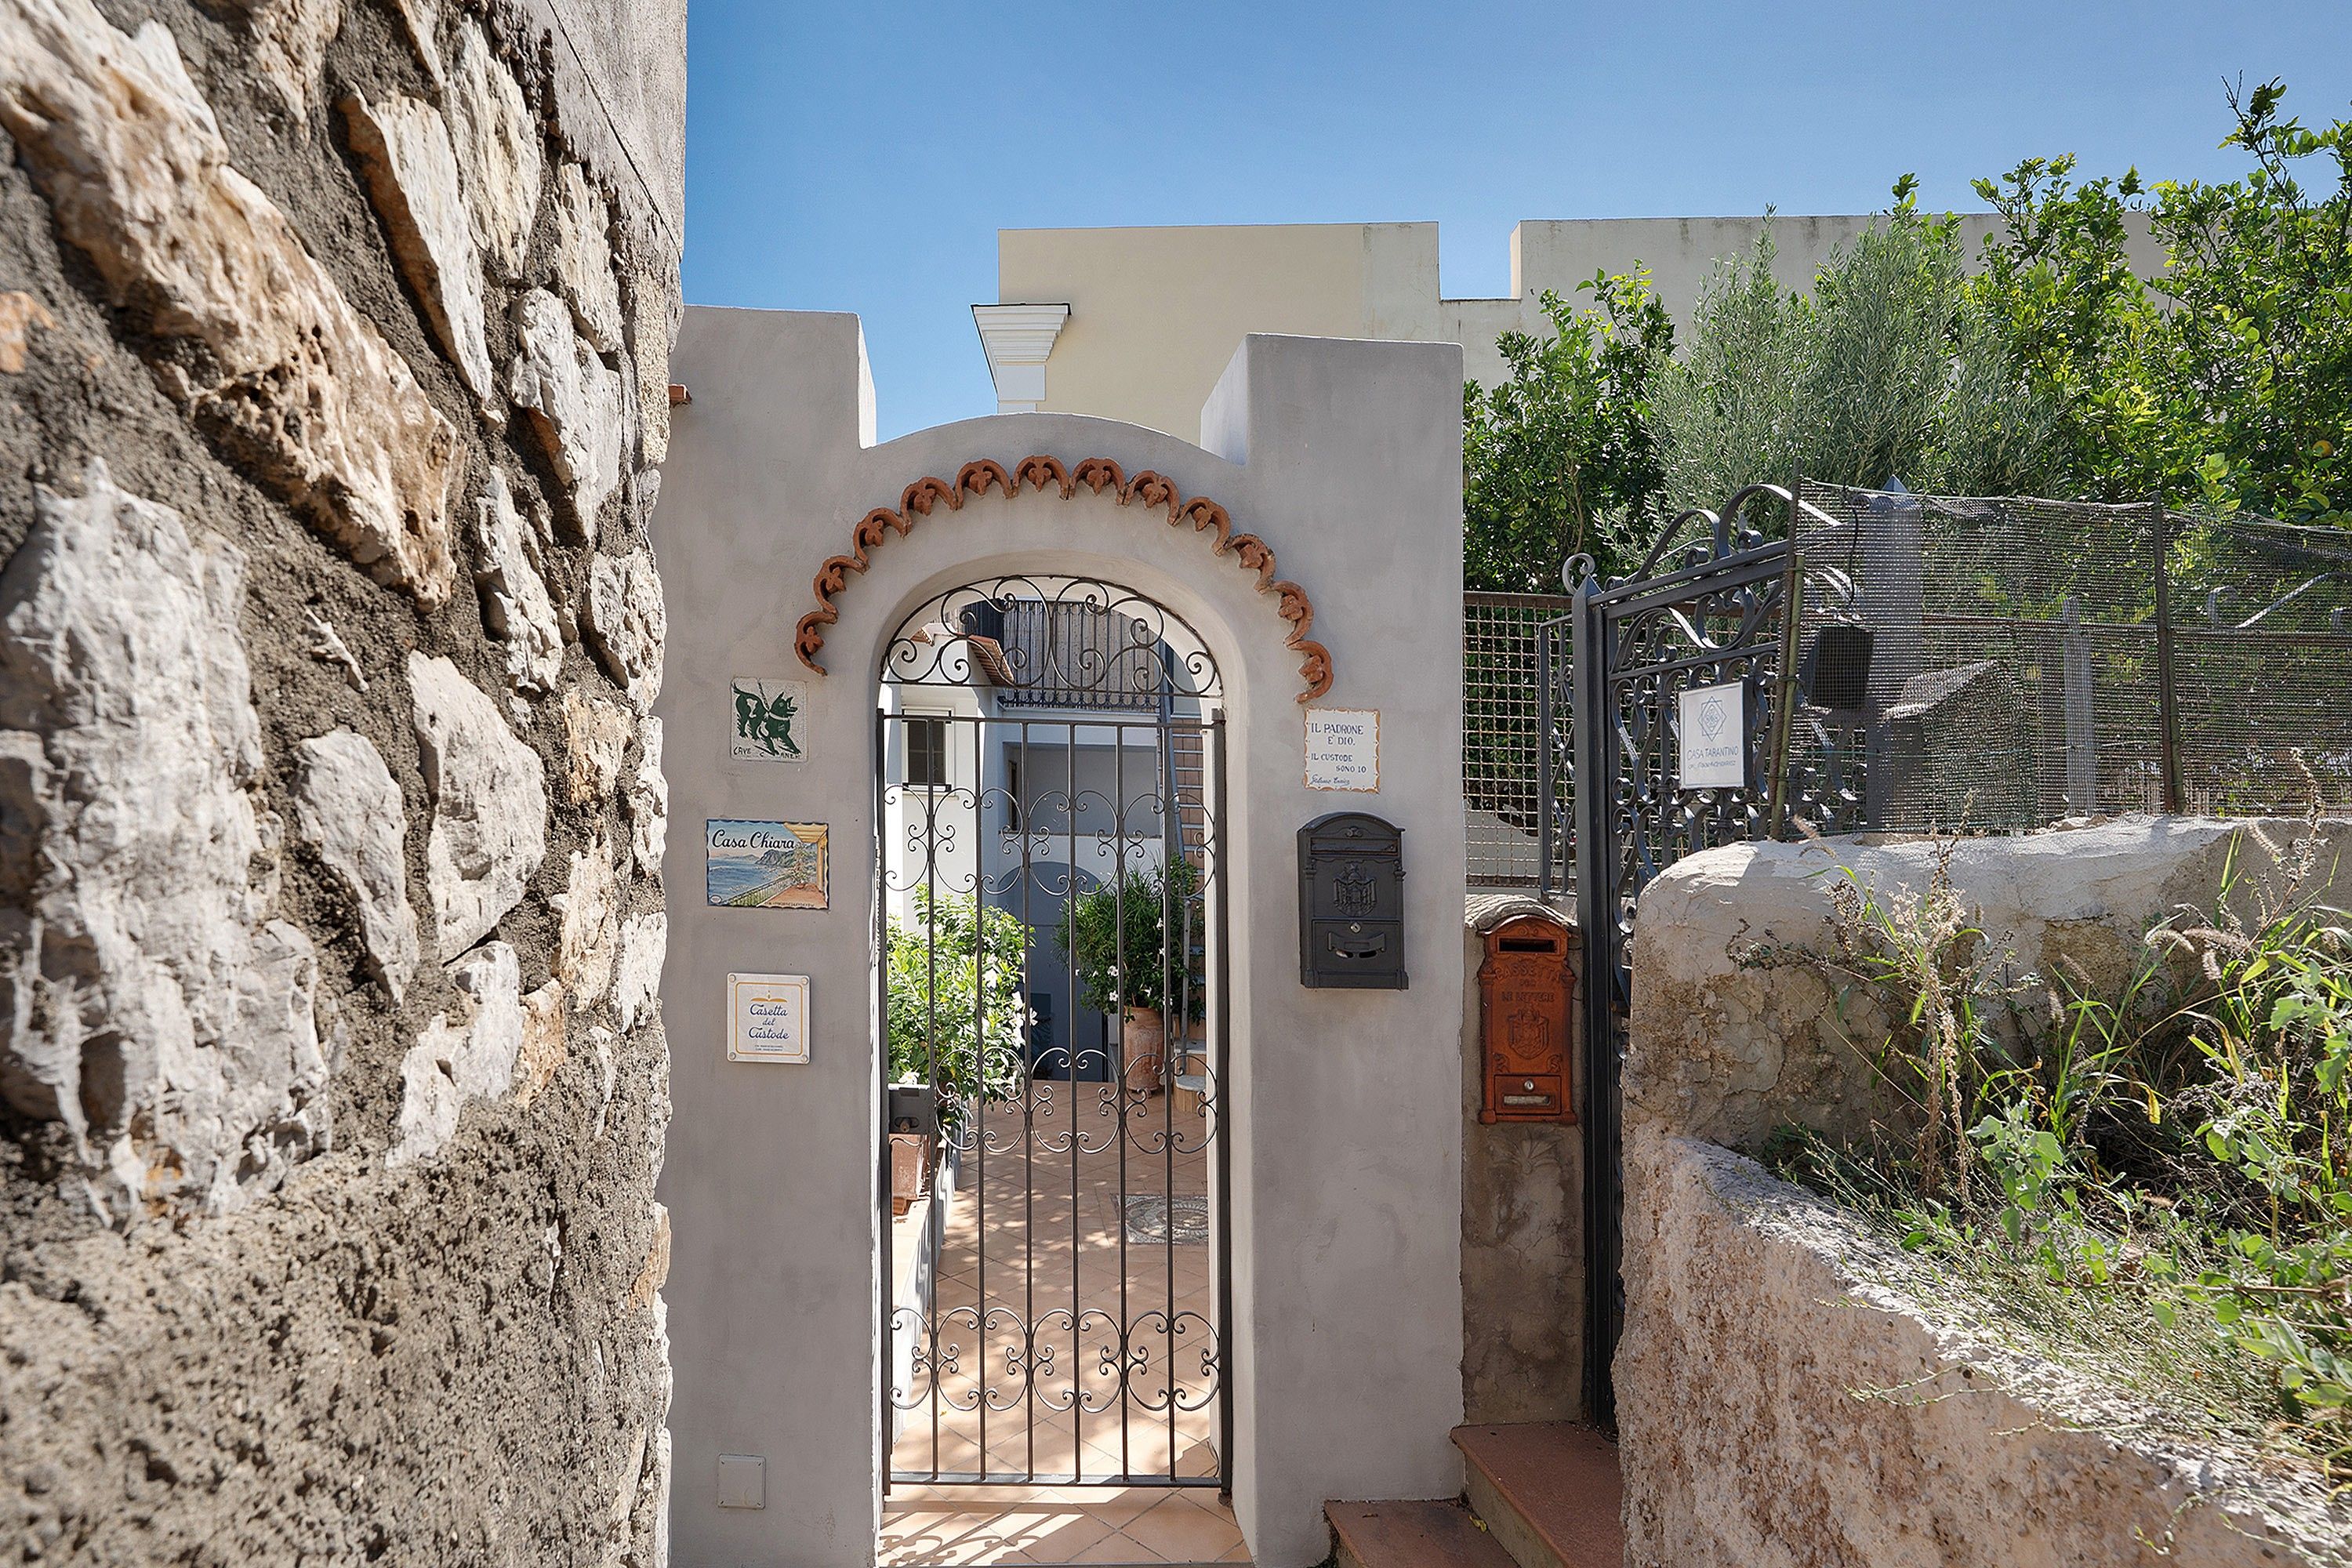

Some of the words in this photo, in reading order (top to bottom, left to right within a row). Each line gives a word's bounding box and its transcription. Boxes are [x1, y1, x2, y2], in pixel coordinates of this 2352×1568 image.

[1311, 723, 1321, 733] IL
[1323, 723, 1363, 735] PADRONE
[1338, 737, 1356, 746] DIO.
[733, 746, 752, 755] CAVE
[1686, 748, 1704, 760] CASA
[1705, 746, 1739, 757] TARANTINO
[1320, 753, 1353, 762] CUSTODE
[712, 829, 747, 848] Casa
[750, 831, 795, 849] Chiara
[1494, 962, 1561, 983] CASSETTA
[750, 1004, 788, 1017] Casetta
[749, 1027, 789, 1040] Custode
